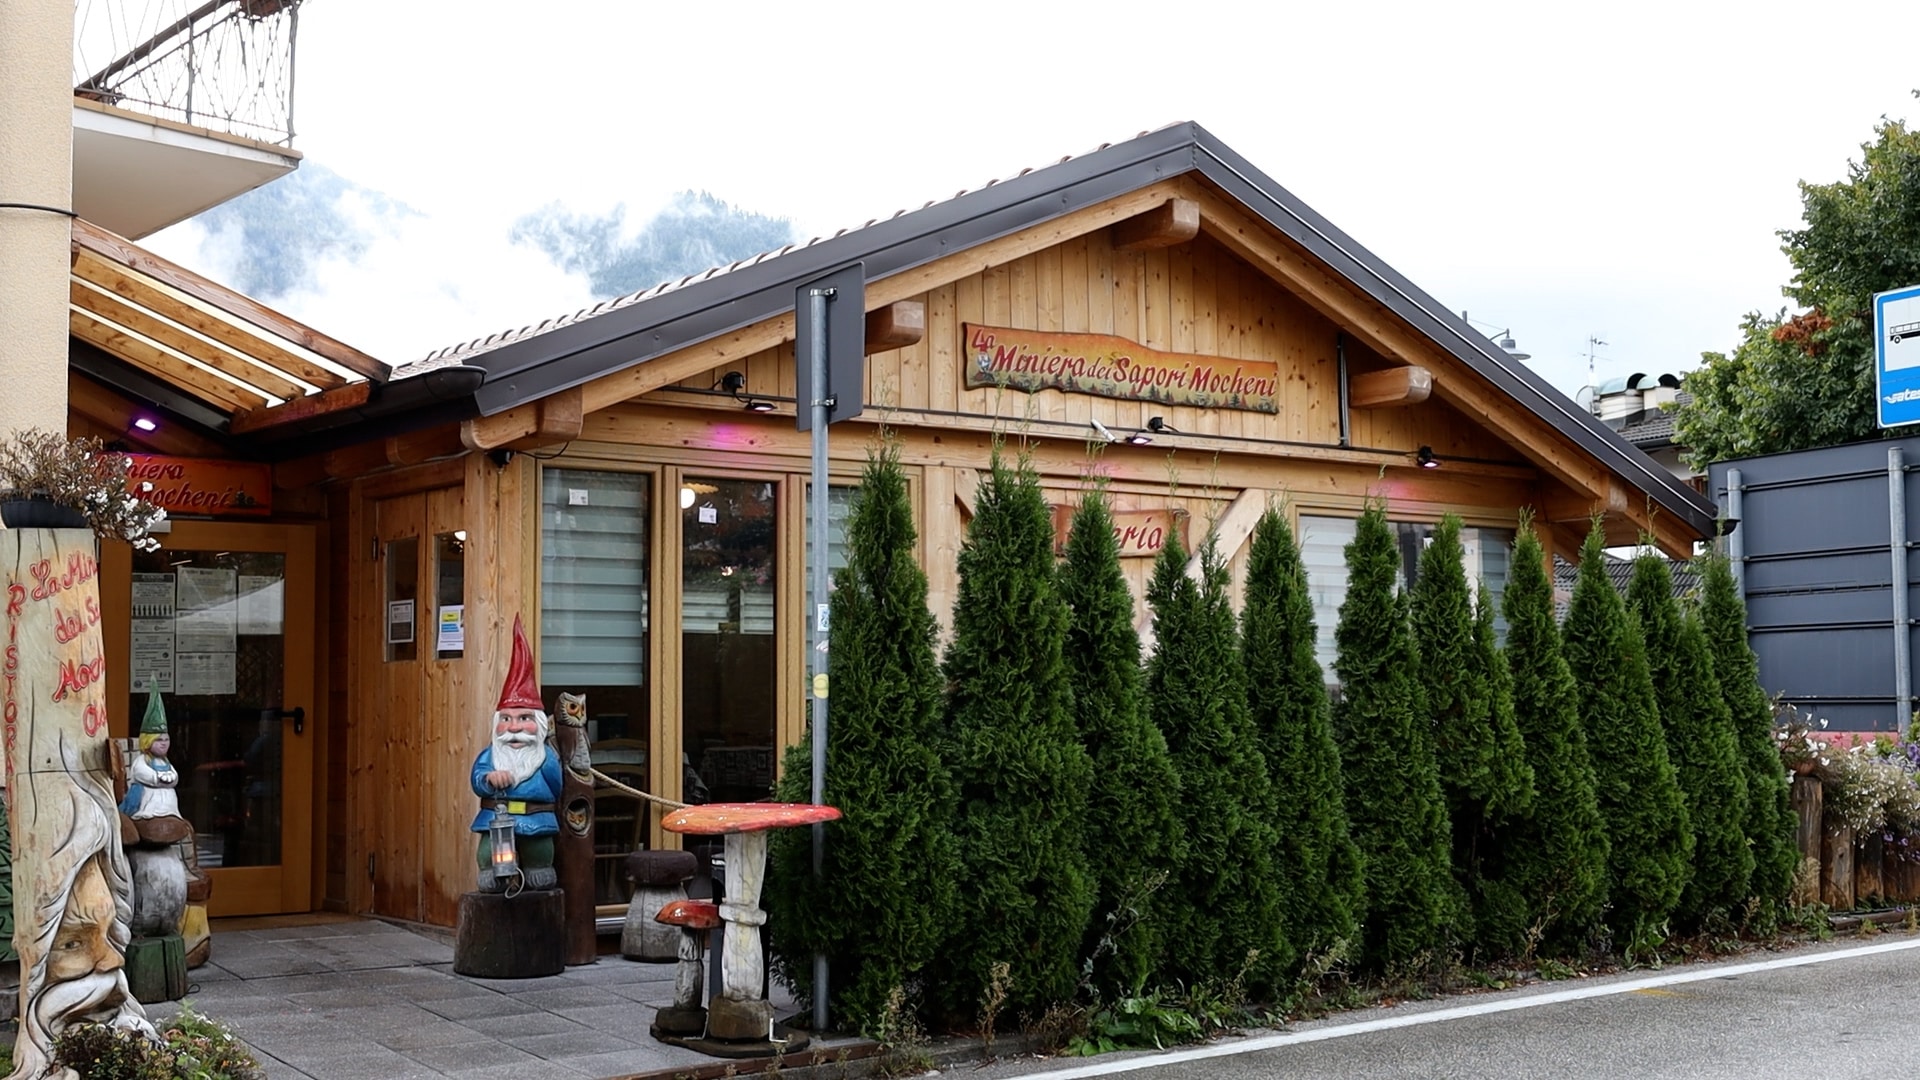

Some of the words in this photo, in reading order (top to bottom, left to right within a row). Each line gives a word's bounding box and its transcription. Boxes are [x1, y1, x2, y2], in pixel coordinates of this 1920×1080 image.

[971, 328, 996, 350] La
[990, 345, 1086, 377] Miniera
[1113, 357, 1190, 393] Sapori
[1188, 366, 1278, 397] Mocheni
